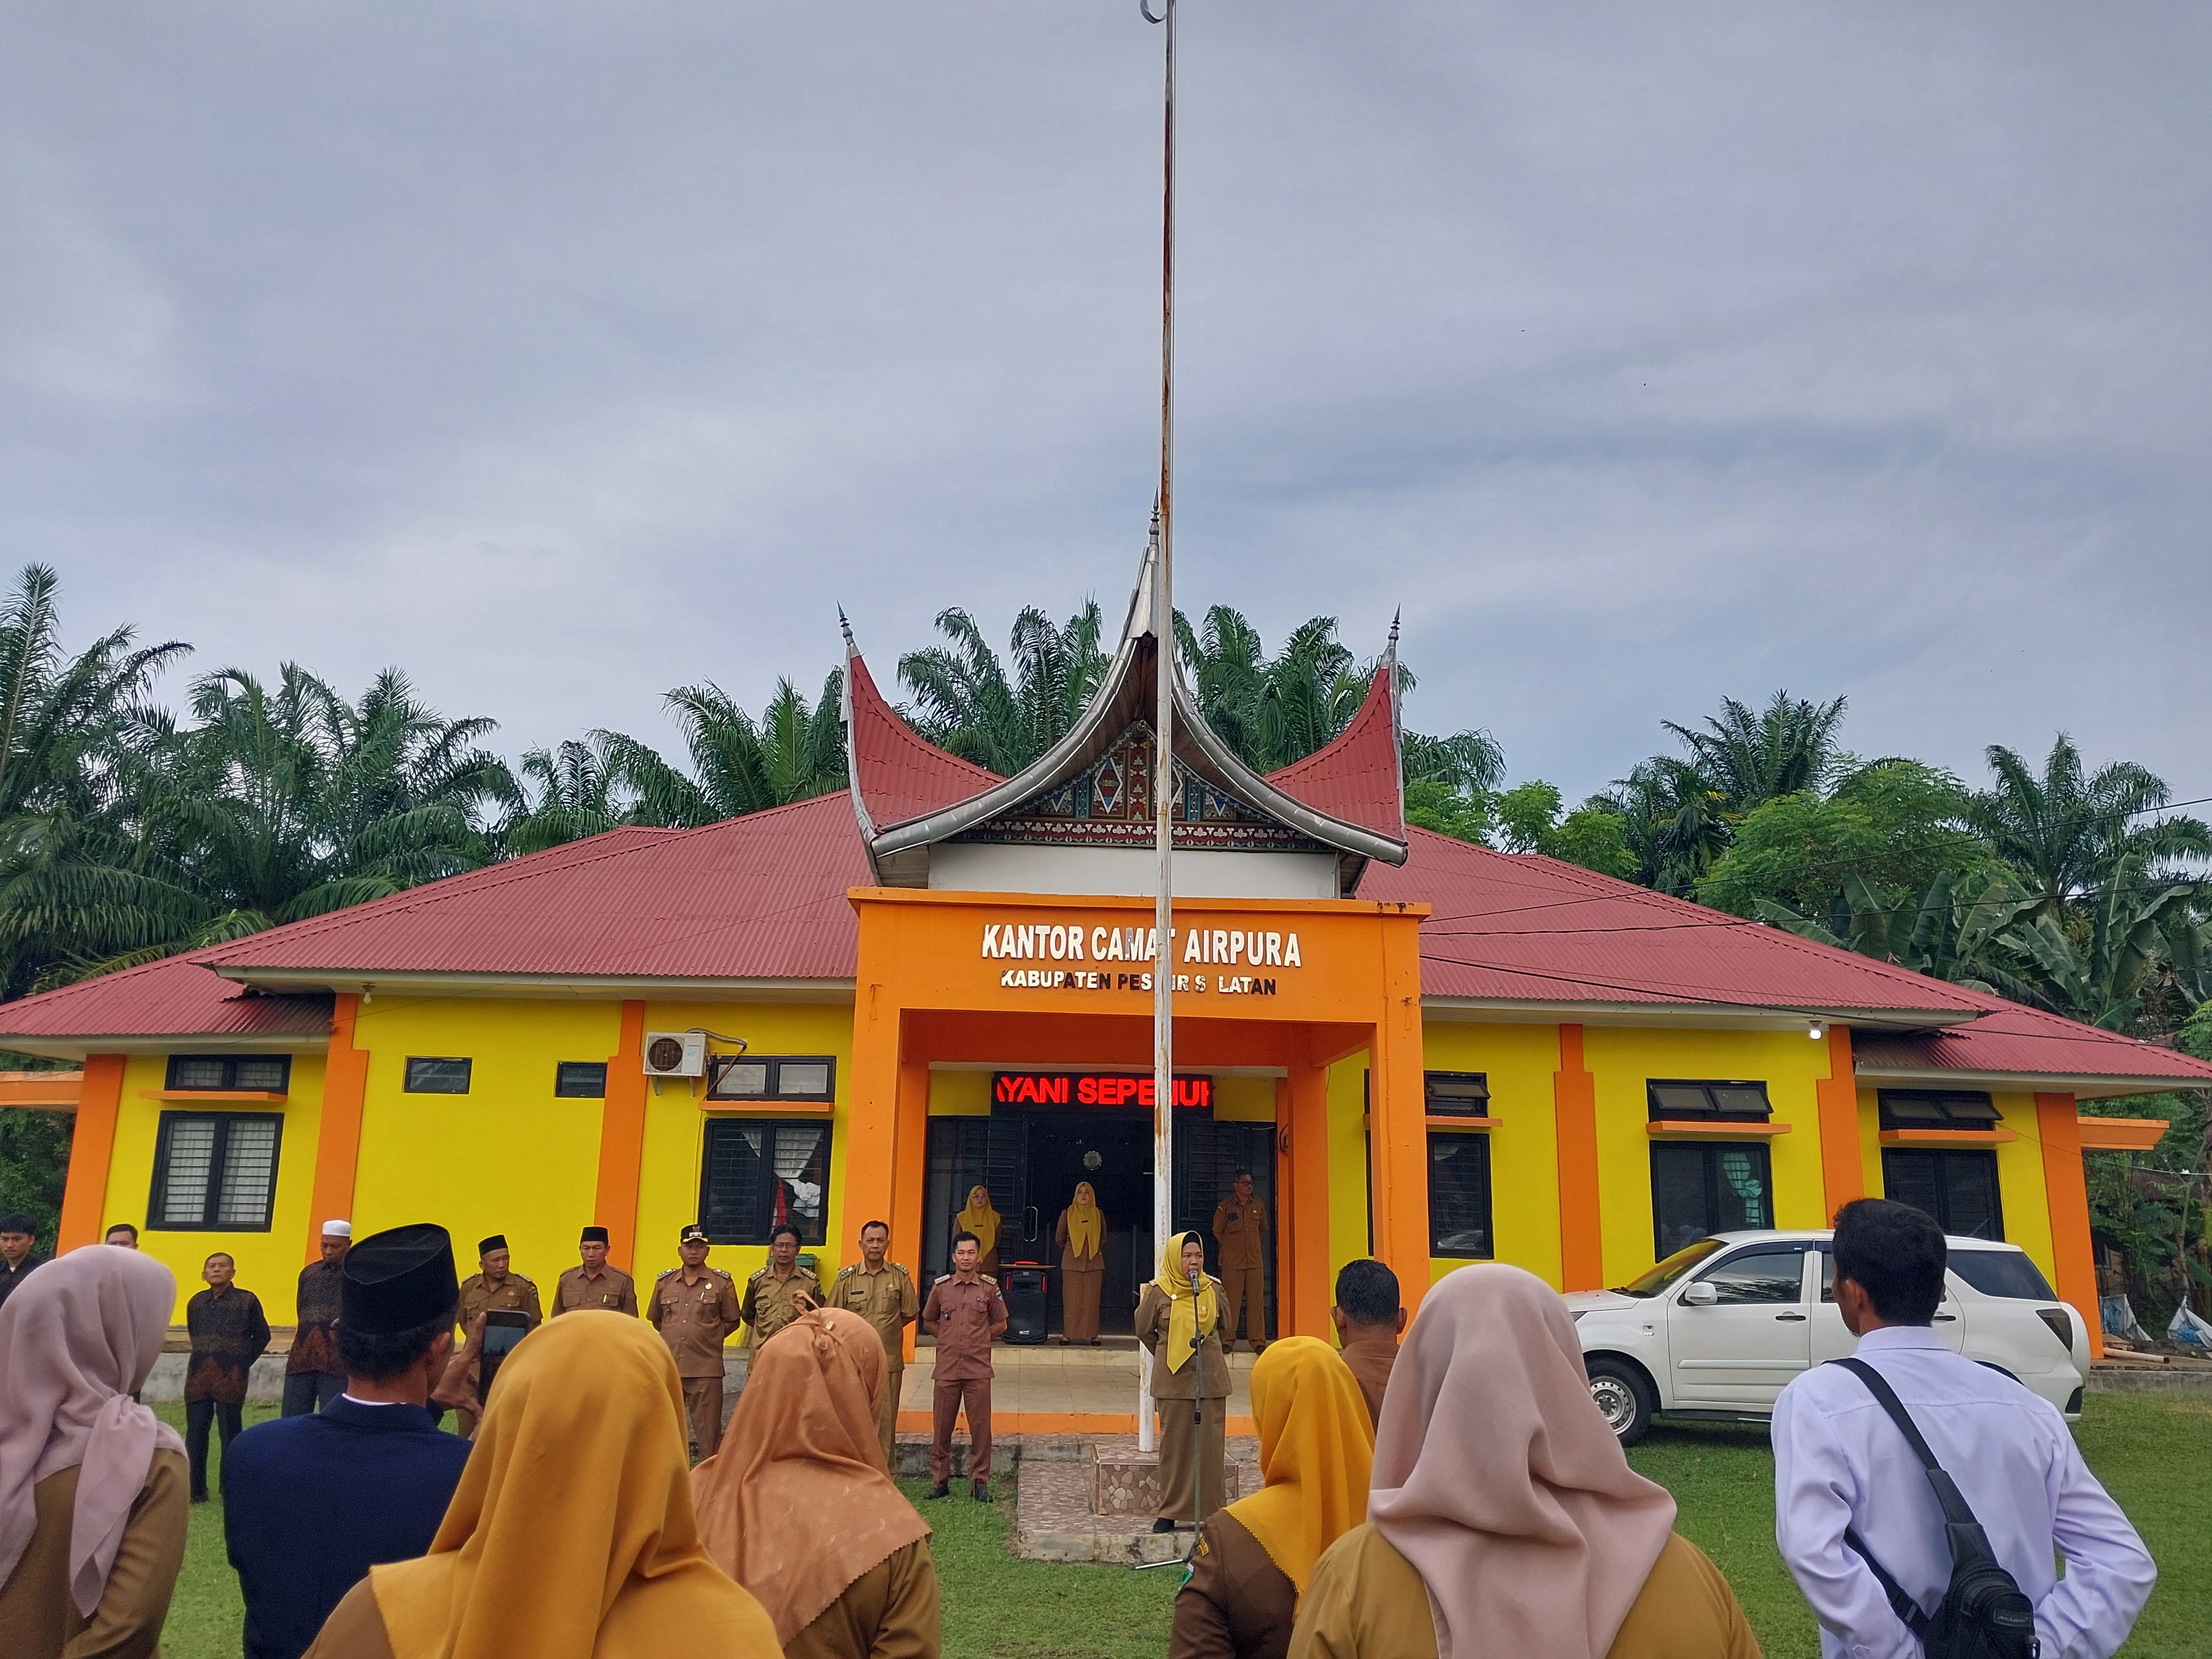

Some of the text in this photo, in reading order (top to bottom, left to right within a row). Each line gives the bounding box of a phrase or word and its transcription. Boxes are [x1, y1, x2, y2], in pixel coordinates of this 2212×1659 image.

[982, 924, 1084, 960] KANTOR
[1184, 929, 1301, 967] AIRPURA
[1001, 969, 1111, 990] KABUPATEN
